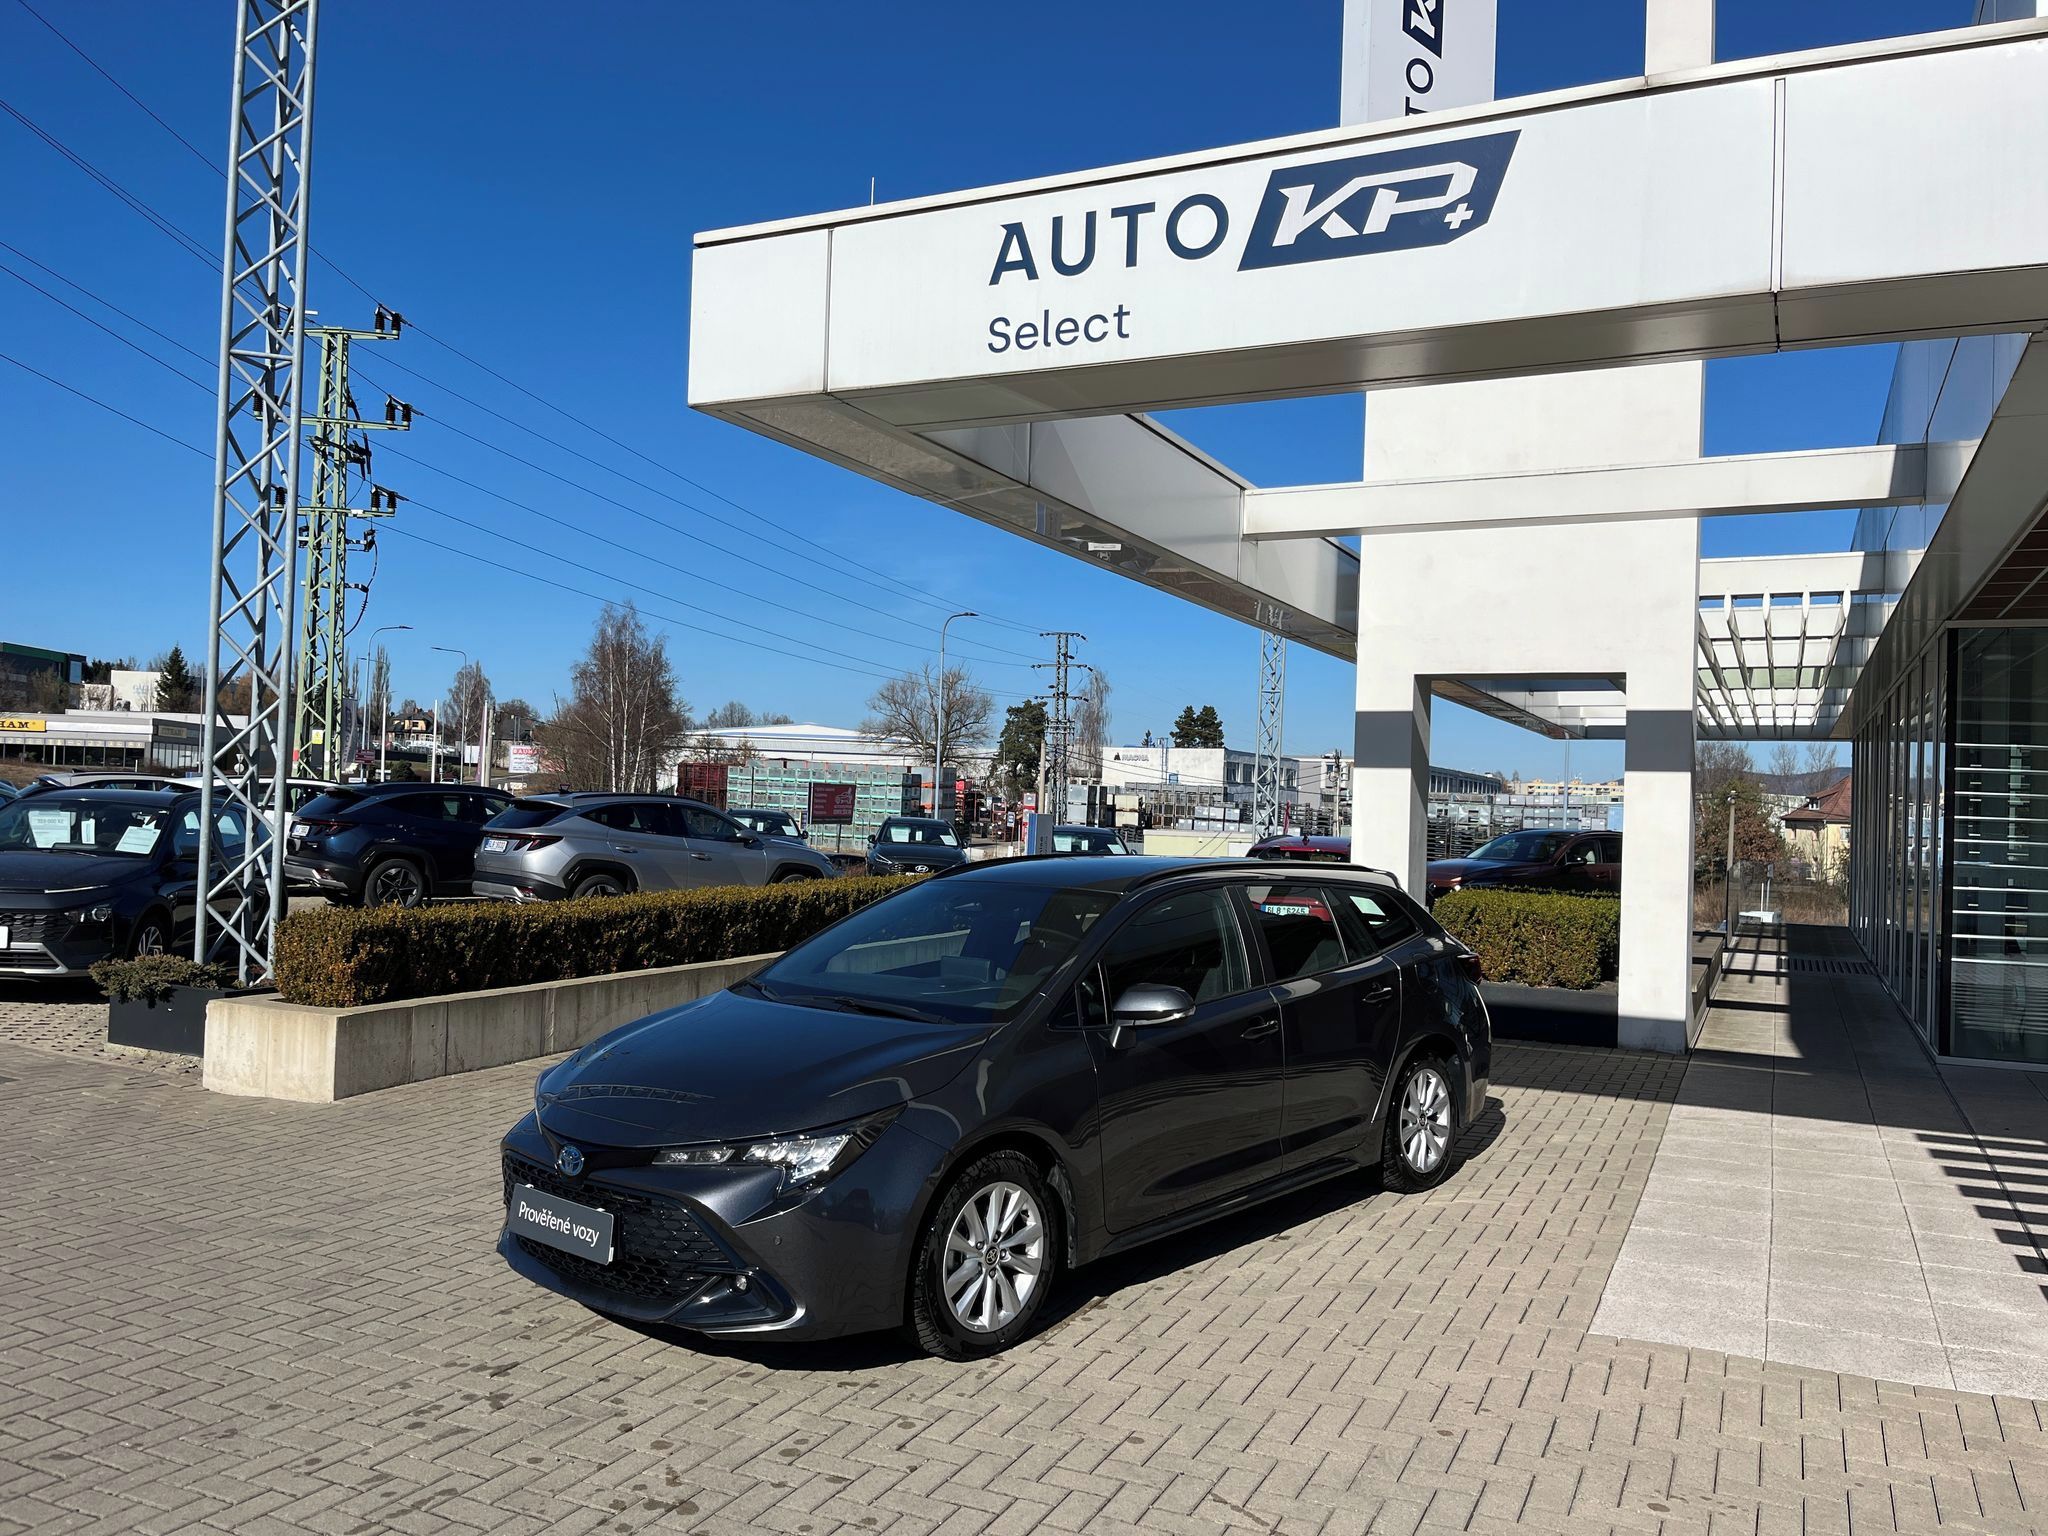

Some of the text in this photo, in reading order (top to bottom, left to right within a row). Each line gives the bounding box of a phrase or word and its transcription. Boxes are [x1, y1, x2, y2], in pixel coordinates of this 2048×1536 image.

[989, 194, 1229, 286] AUTO
[987, 304, 1131, 353] Select
[518, 1201, 600, 1248] Prověřené vozy
